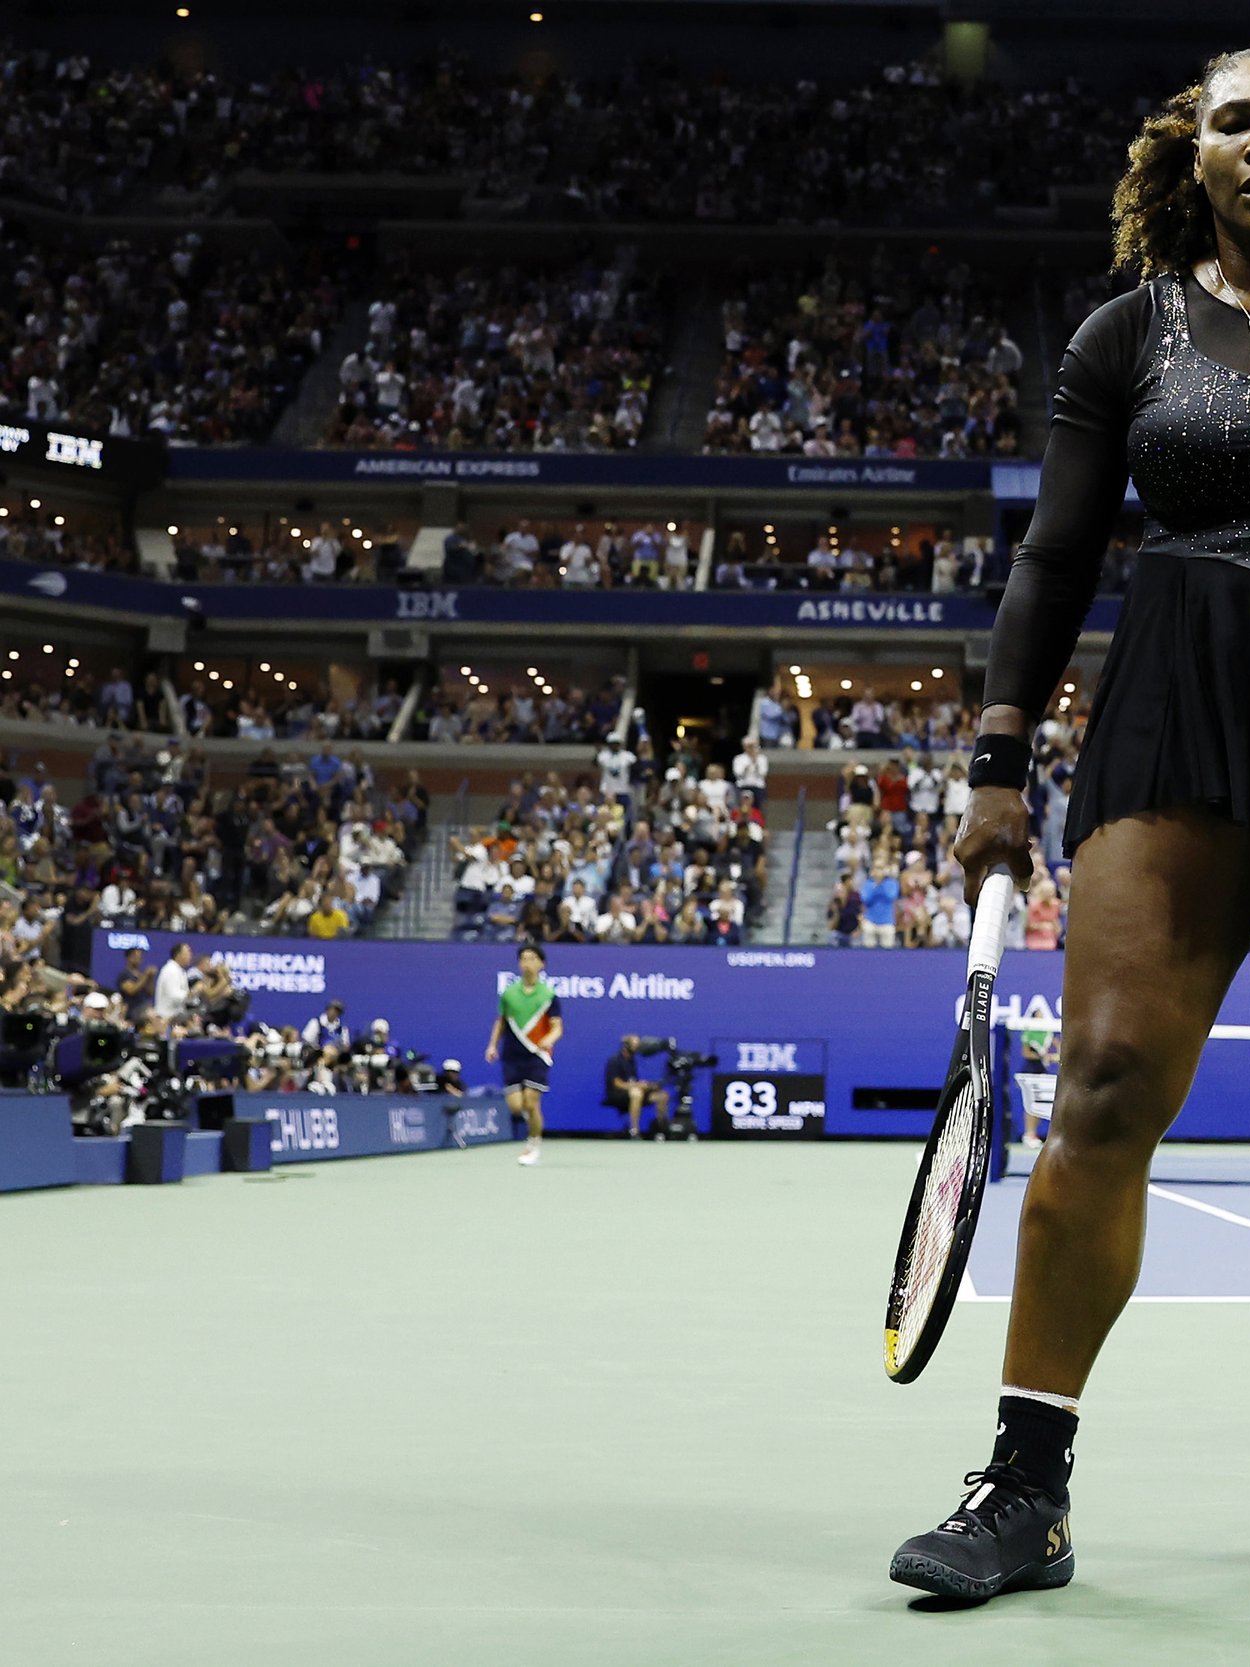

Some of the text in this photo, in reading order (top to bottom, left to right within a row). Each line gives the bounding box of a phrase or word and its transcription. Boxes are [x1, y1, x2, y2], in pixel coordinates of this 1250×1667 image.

[46, 432, 103, 469] IBM
[355, 458, 540, 476] AMERICAN EXPRESS
[398, 591, 458, 617] IBM
[798, 600, 944, 622] ASHEVILLE
[608, 972, 695, 1000] Airline
[976, 982, 990, 1022] BLADE
[736, 1042, 798, 1072] IBM
[724, 1080, 778, 1118] 83
